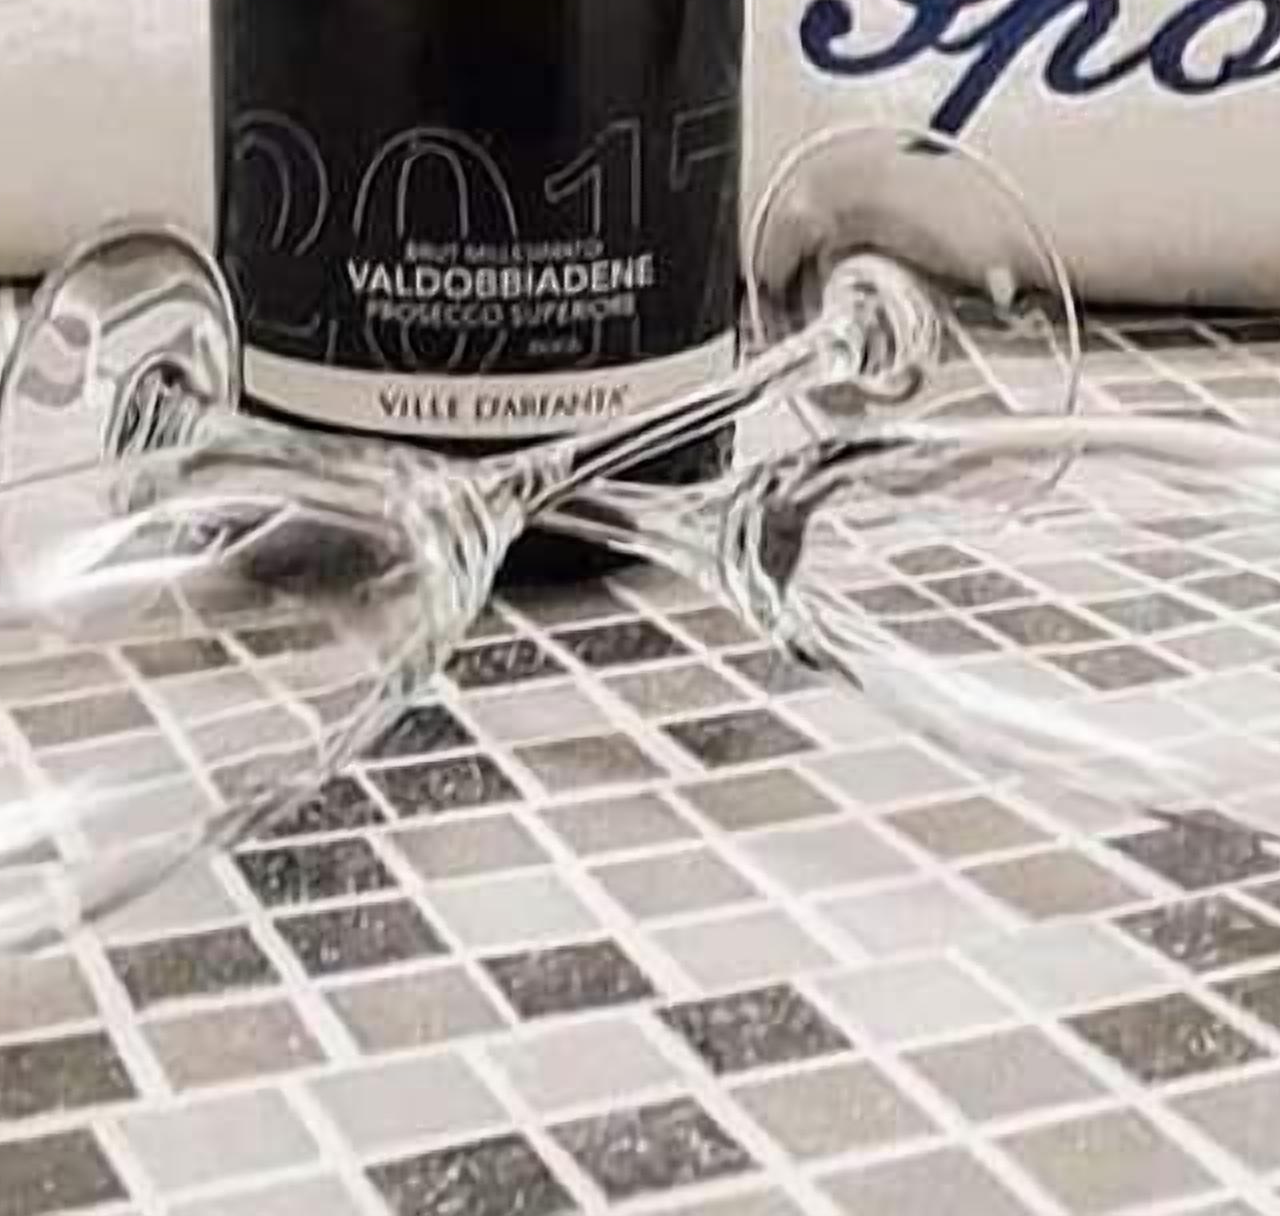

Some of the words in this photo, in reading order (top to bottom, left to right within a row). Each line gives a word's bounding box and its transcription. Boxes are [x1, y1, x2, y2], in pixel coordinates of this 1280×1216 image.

[347, 252, 655, 300] VALDOBBIADENE
[365, 299, 505, 329] PROSECCO
[379, 391, 458, 420] VILLE
